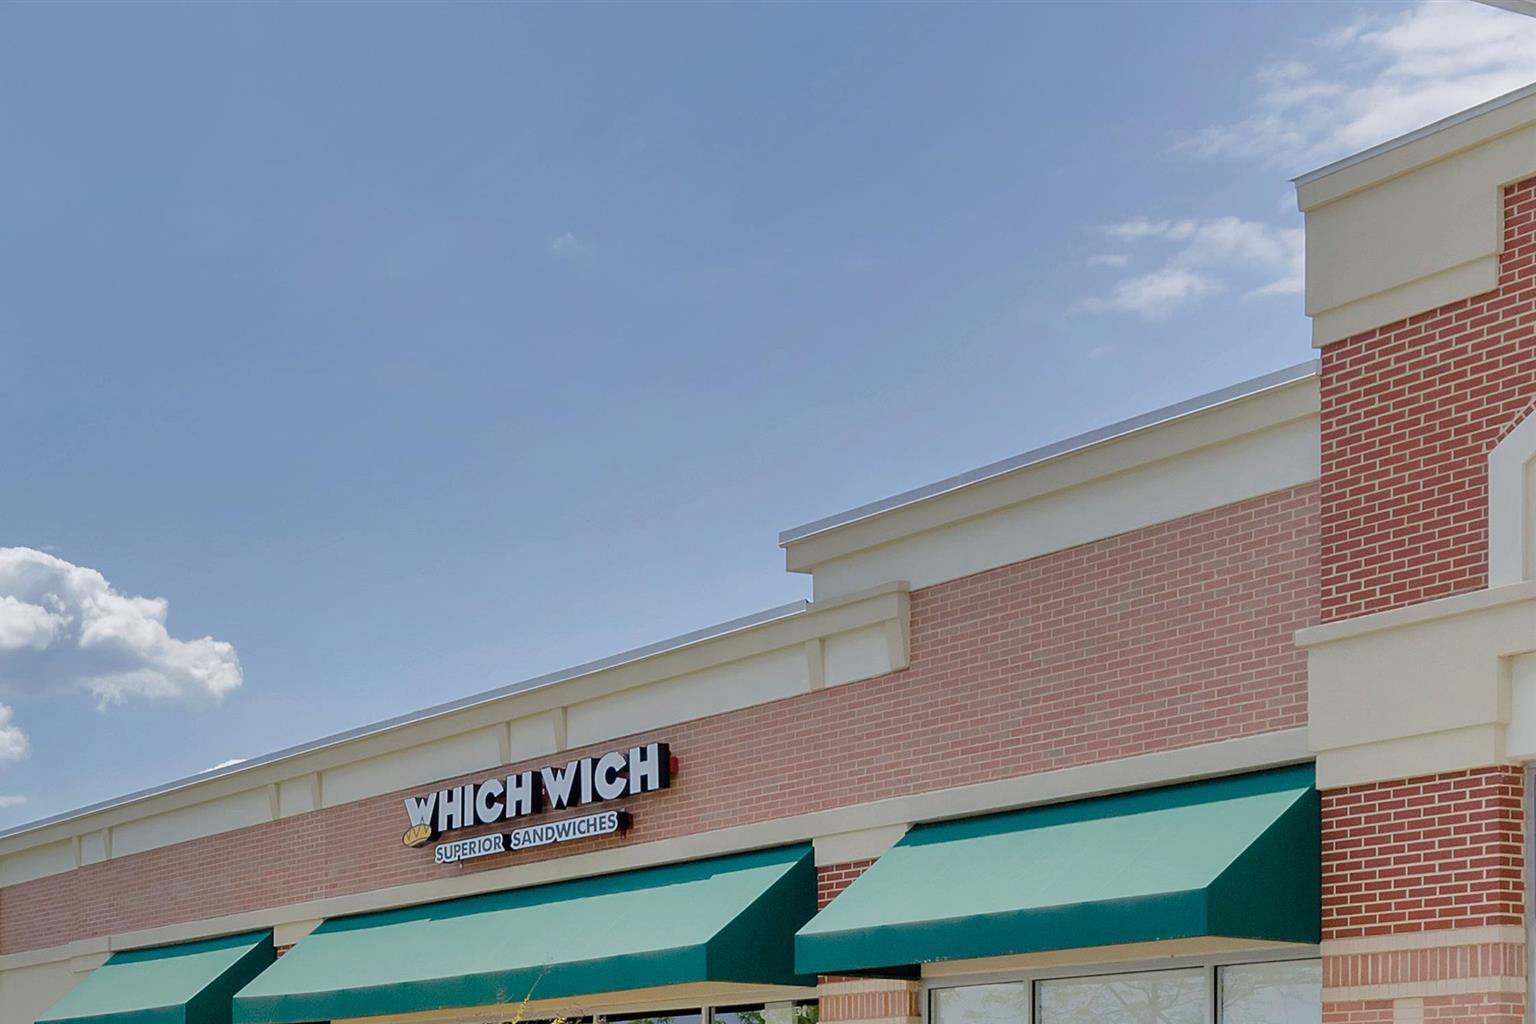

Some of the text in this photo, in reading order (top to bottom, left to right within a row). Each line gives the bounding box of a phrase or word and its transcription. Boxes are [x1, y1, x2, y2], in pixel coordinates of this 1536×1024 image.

[403, 743, 662, 832] WHICH WICH
[435, 811, 617, 863] SUPERIOR SANDWICHES
